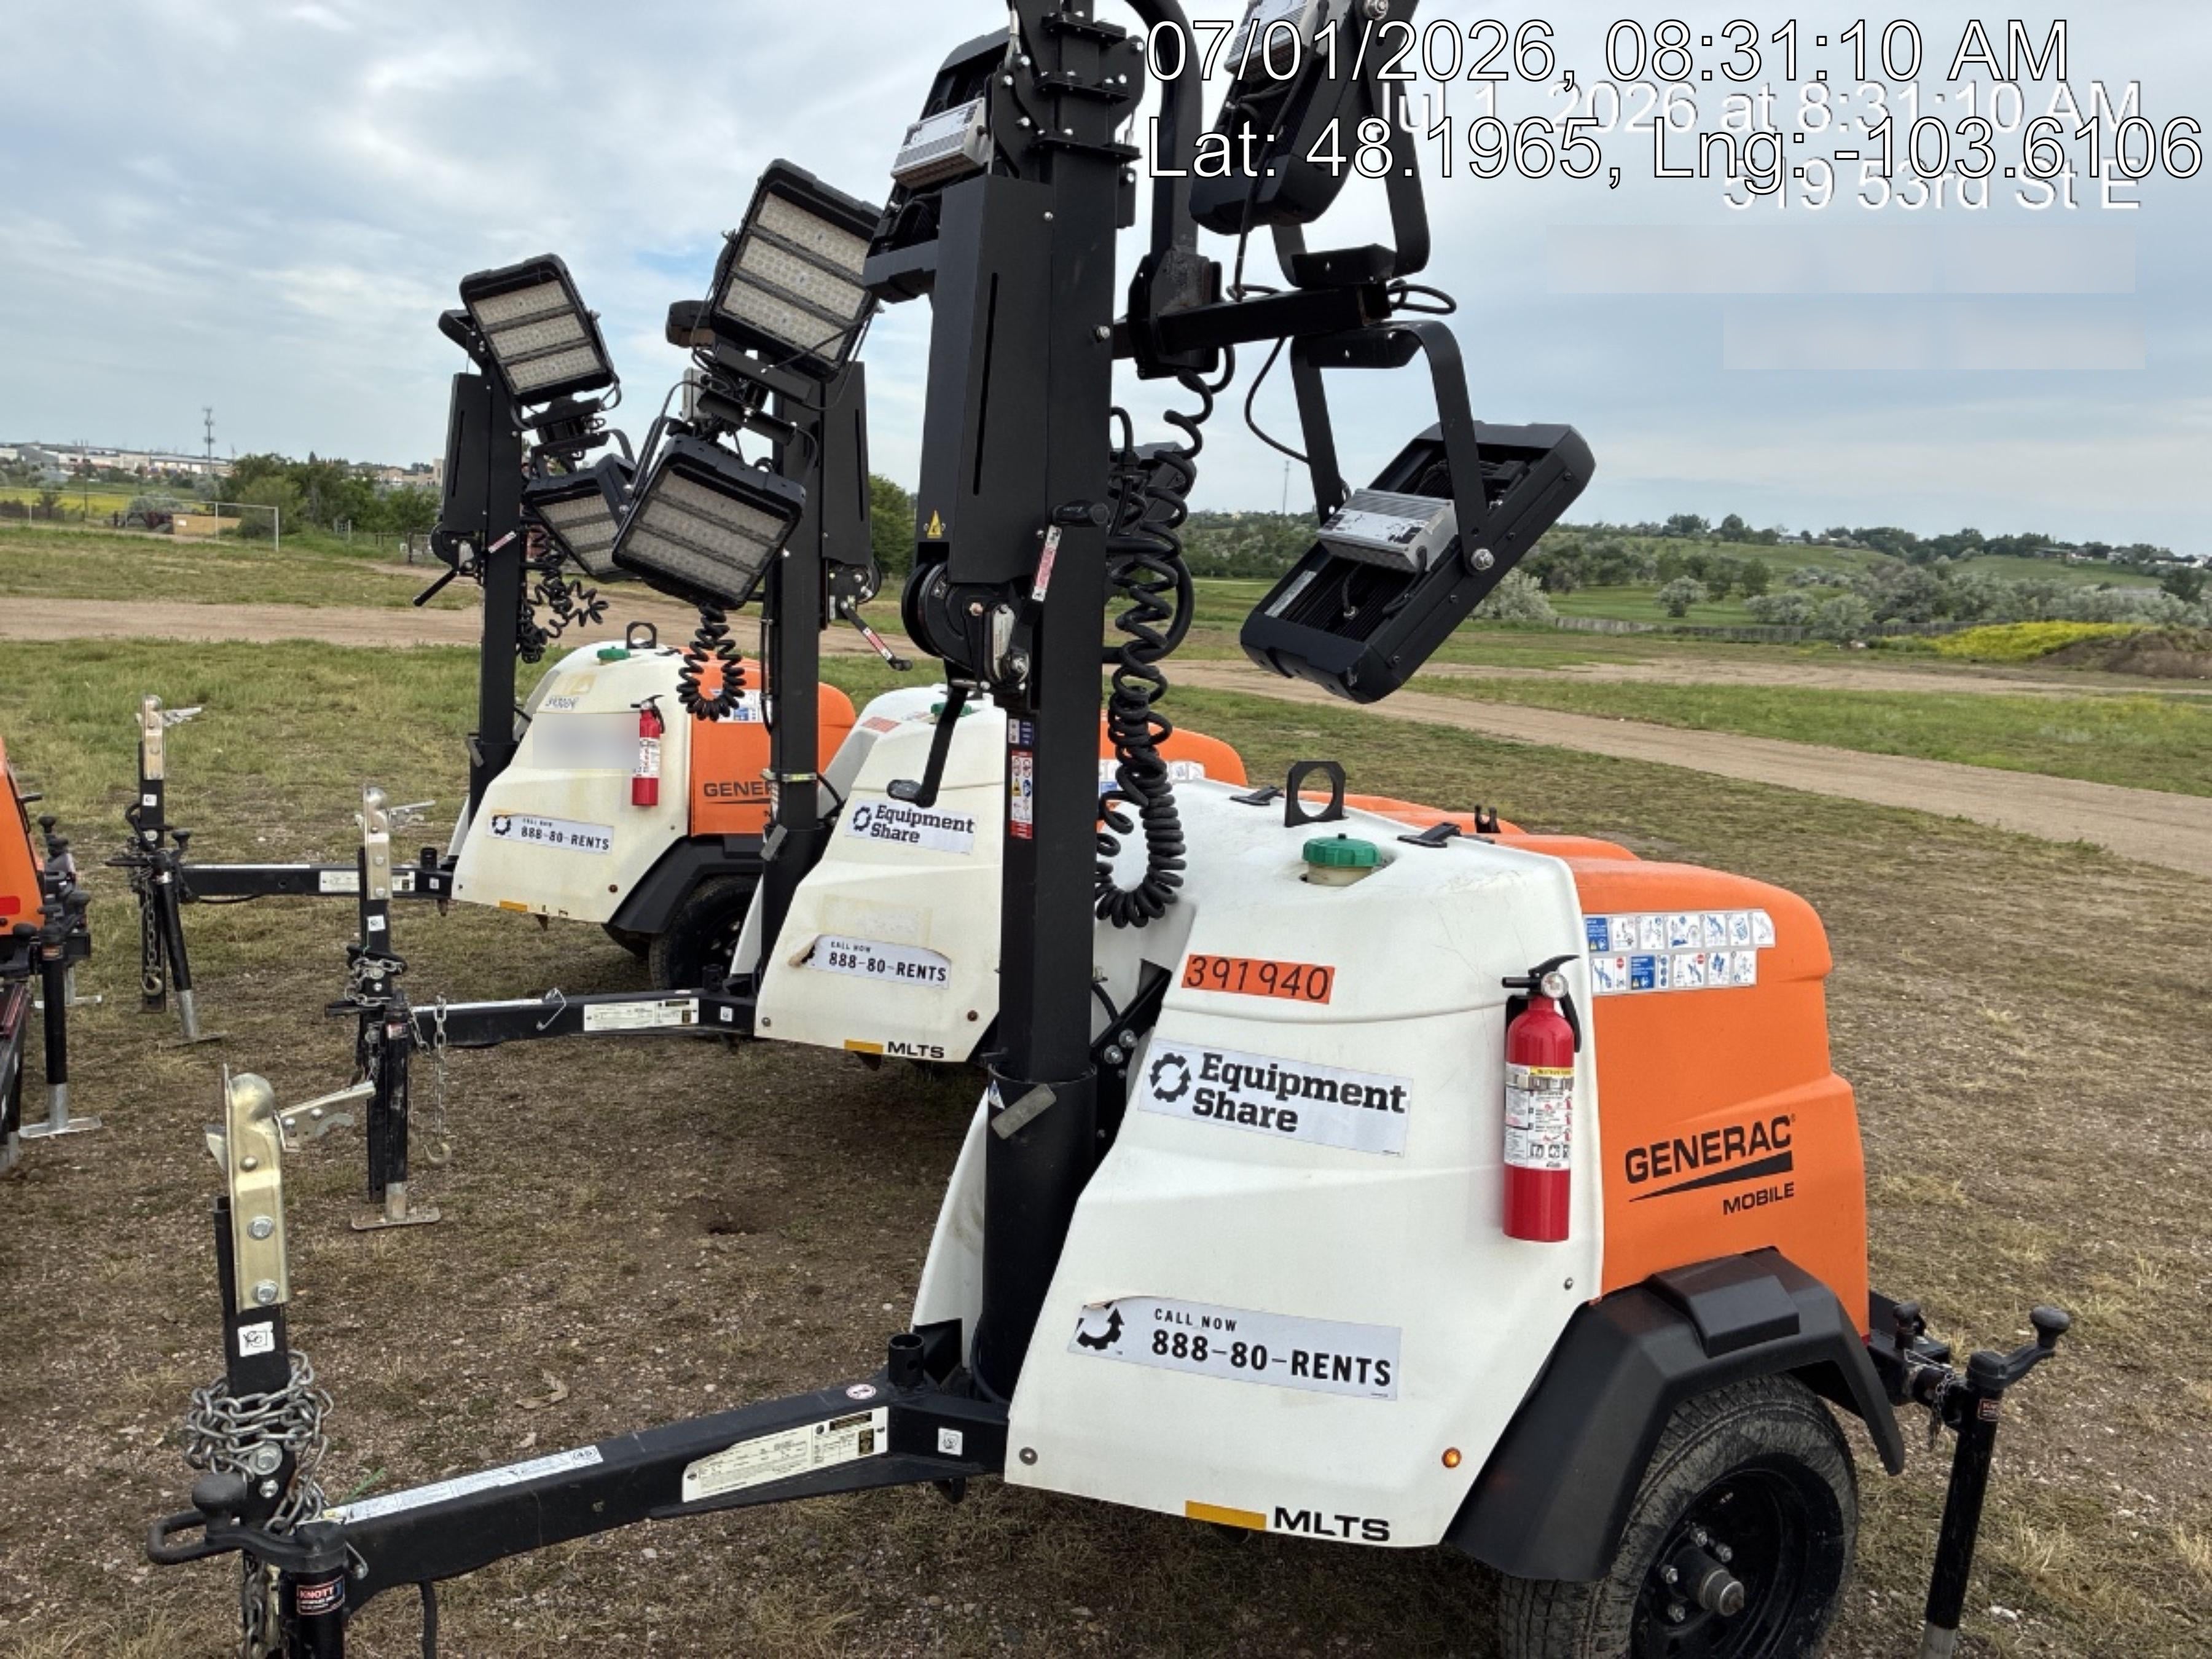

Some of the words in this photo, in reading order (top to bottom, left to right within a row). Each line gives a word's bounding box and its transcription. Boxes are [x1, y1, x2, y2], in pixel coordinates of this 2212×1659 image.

[870, 822, 920, 844] Share
[875, 804, 975, 833] Equipment
[521, 826, 609, 850] 888-80-RENTS
[829, 951, 947, 982] 888-80-RENTS
[1187, 956, 1330, 1000] 391940
[887, 1041, 945, 1059] MLTS
[1199, 1052, 1407, 1114] Equipment
[1192, 1087, 1298, 1133] Share
[1625, 1114, 1792, 1184] GENERAC
[1723, 1181, 1795, 1215] MOBILE
[1155, 1308, 1193, 1326] CALL
[1201, 1316, 1237, 1332] NOW
[1151, 1328, 1391, 1387] 888-80-RENTS
[1274, 1506, 1390, 1542] MLTS
